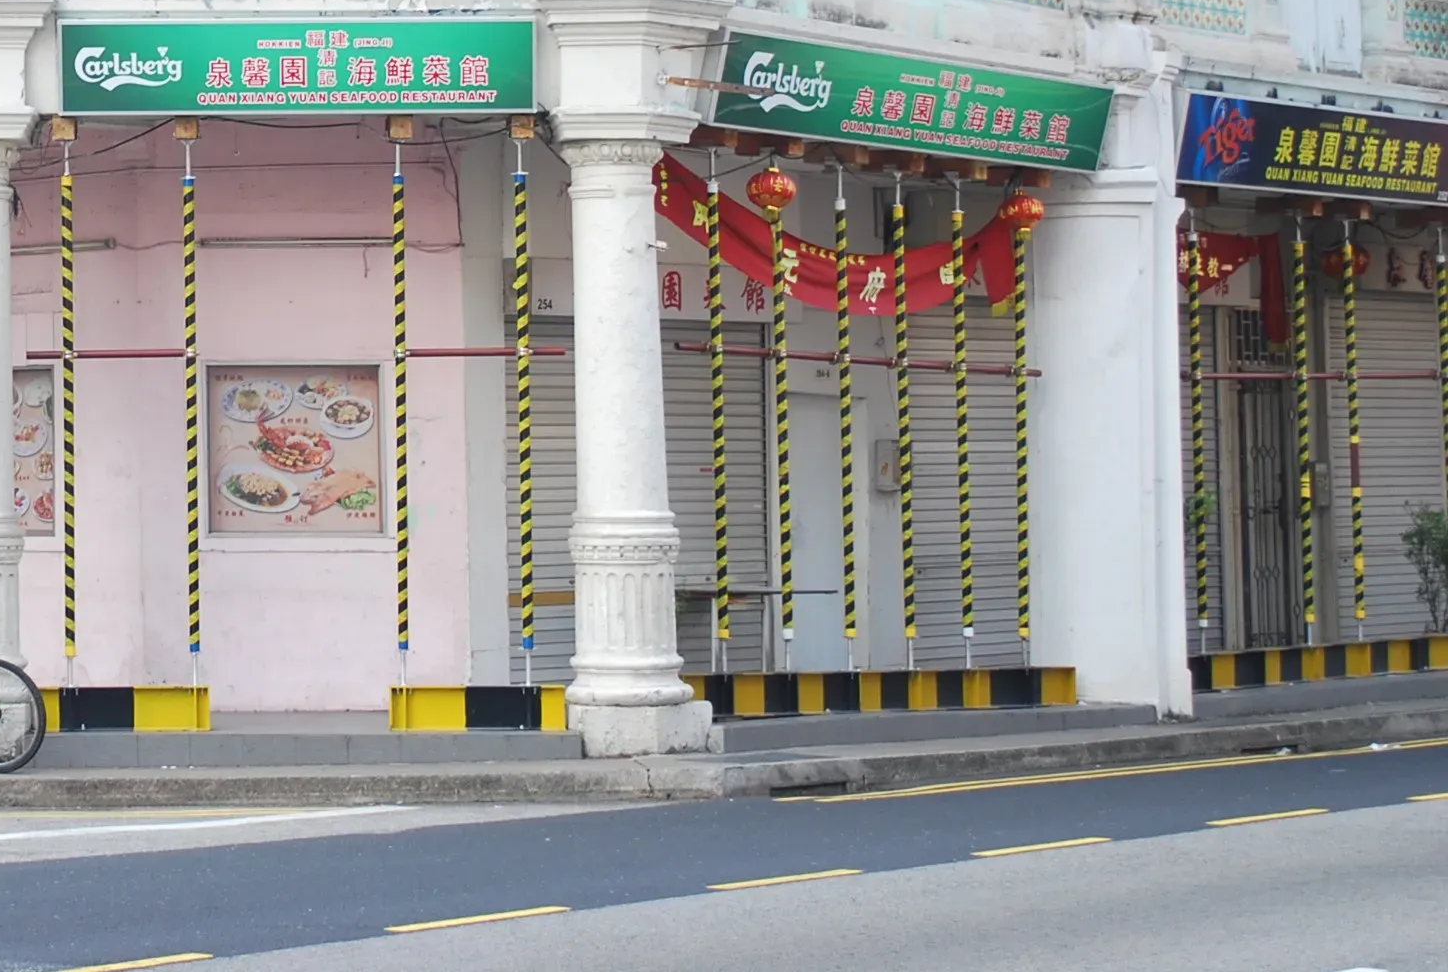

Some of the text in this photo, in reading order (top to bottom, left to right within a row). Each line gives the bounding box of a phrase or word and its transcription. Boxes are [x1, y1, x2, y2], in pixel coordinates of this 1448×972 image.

[258, 40, 301, 48] HOKKIEN
[306, 30, 349, 47] 福建
[74, 46, 183, 85] Carlsberg
[206, 57, 307, 87] 泉馨園
[317, 48, 337, 86] 清記
[348, 55, 490, 86] 海鮮菜館
[744, 51, 832, 109] Carlsberg
[938, 70, 972, 92] 福建
[198, 90, 497, 104] QUAN XIANG YUAN SEAFOOD RESTAURANT
[851, 86, 936, 126] 泉馨園
[840, 120, 1069, 160] QUAN XIANG YUAN SEAFOOD RESTAURANT
[963, 102, 1071, 144] 海鮮菜館
[1200, 109, 1255, 167] Tiger
[1274, 126, 1341, 168] 泉馨園
[1358, 136, 1442, 178] 海鮮菜館
[1265, 166, 1438, 193] QUAN XIANG YUAN SEAFOOD RESTAURANT
[537, 299, 553, 310] 254
